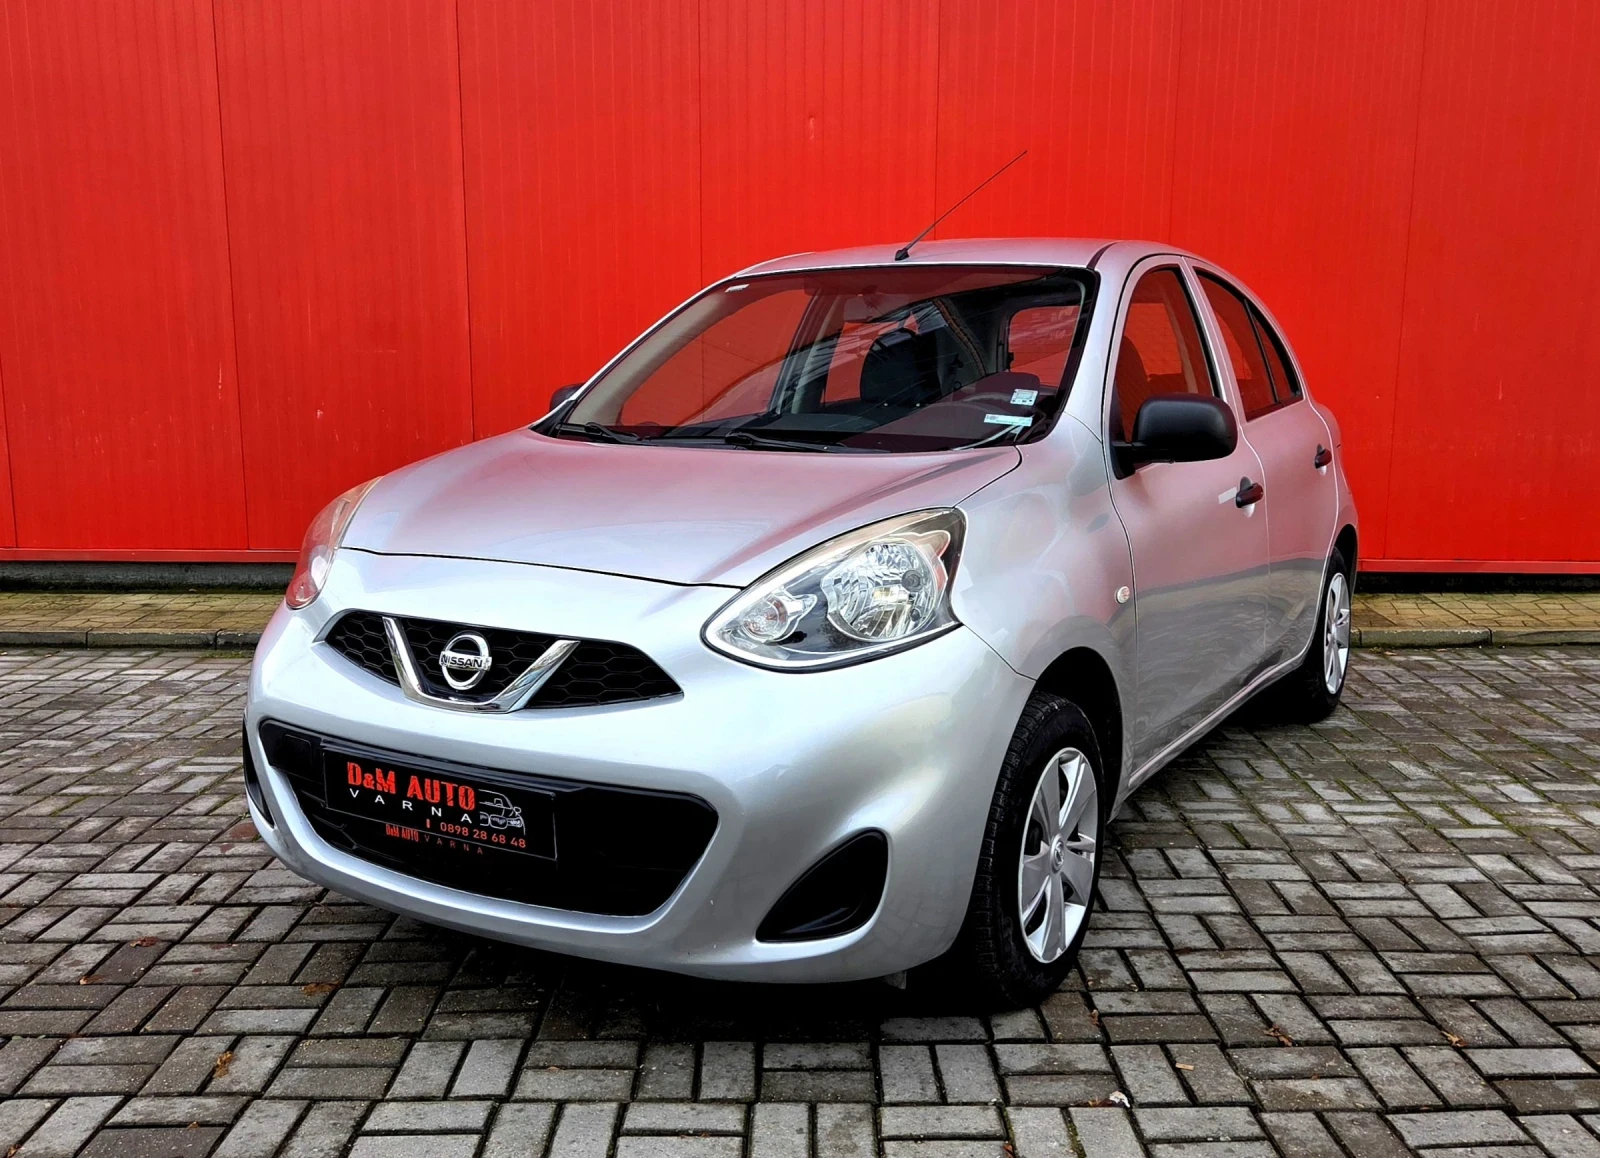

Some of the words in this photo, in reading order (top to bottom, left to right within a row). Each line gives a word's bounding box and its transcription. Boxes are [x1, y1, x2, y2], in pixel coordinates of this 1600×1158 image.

[440, 654, 483, 668] NISSAN
[347, 761, 397, 795] D&M
[407, 775, 476, 811] AUTO
[349, 788, 473, 824] VARNA
[385, 823, 400, 838] D&M
[401, 827, 420, 843] AUTO
[440, 821, 469, 837] 0898
[473, 828, 488, 840] 28
[491, 832, 506, 844] 68
[510, 836, 526, 848] 48
